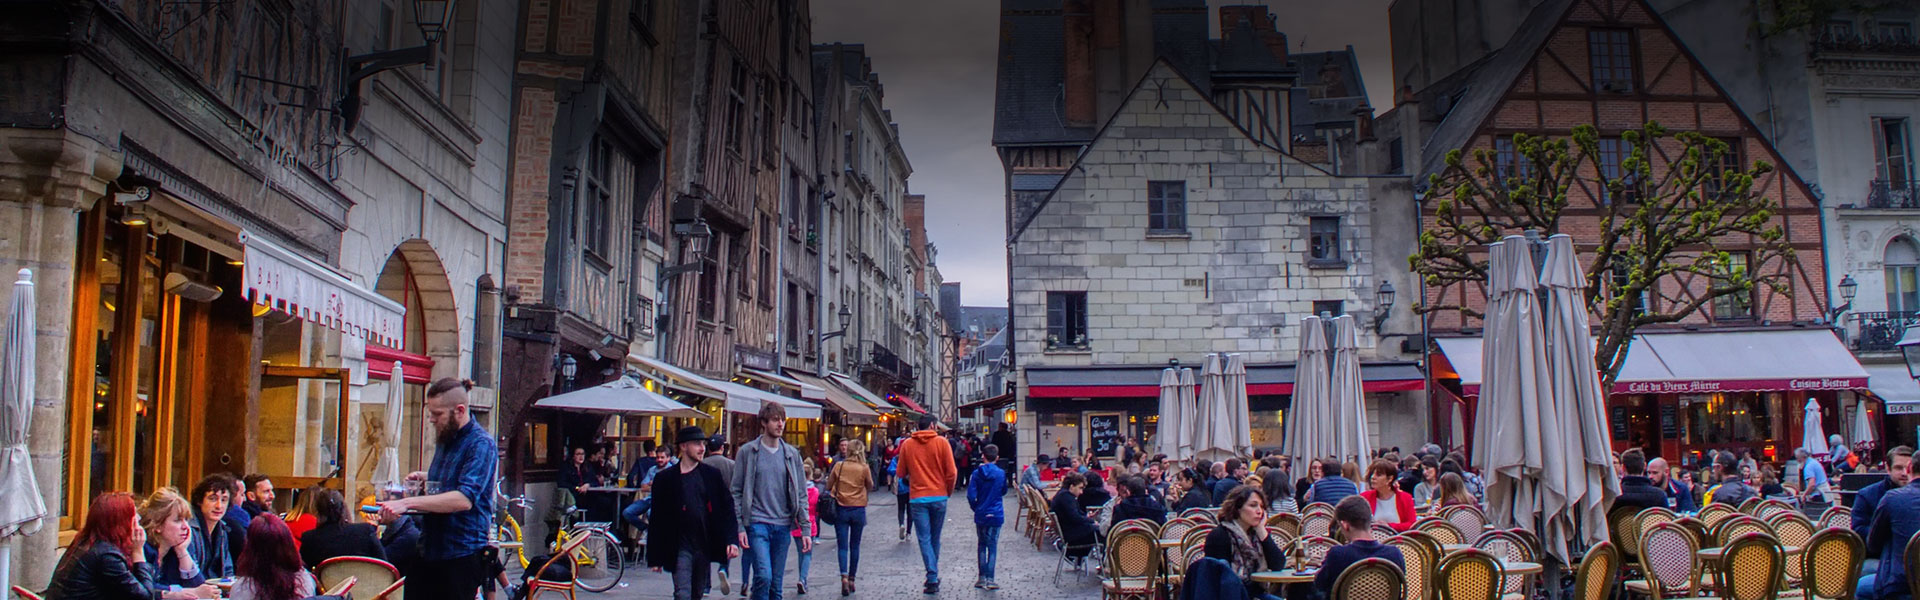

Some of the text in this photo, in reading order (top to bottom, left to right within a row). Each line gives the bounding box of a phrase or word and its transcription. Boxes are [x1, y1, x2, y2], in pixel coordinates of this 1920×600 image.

[257, 266, 280, 291] BAR
[1629, 381, 1649, 392] Café
[1650, 382, 1661, 391] du
[1663, 381, 1689, 391] Vieux
[1789, 378, 1850, 389] Cuisine Bistrot
[1890, 405, 1914, 413] BAR
